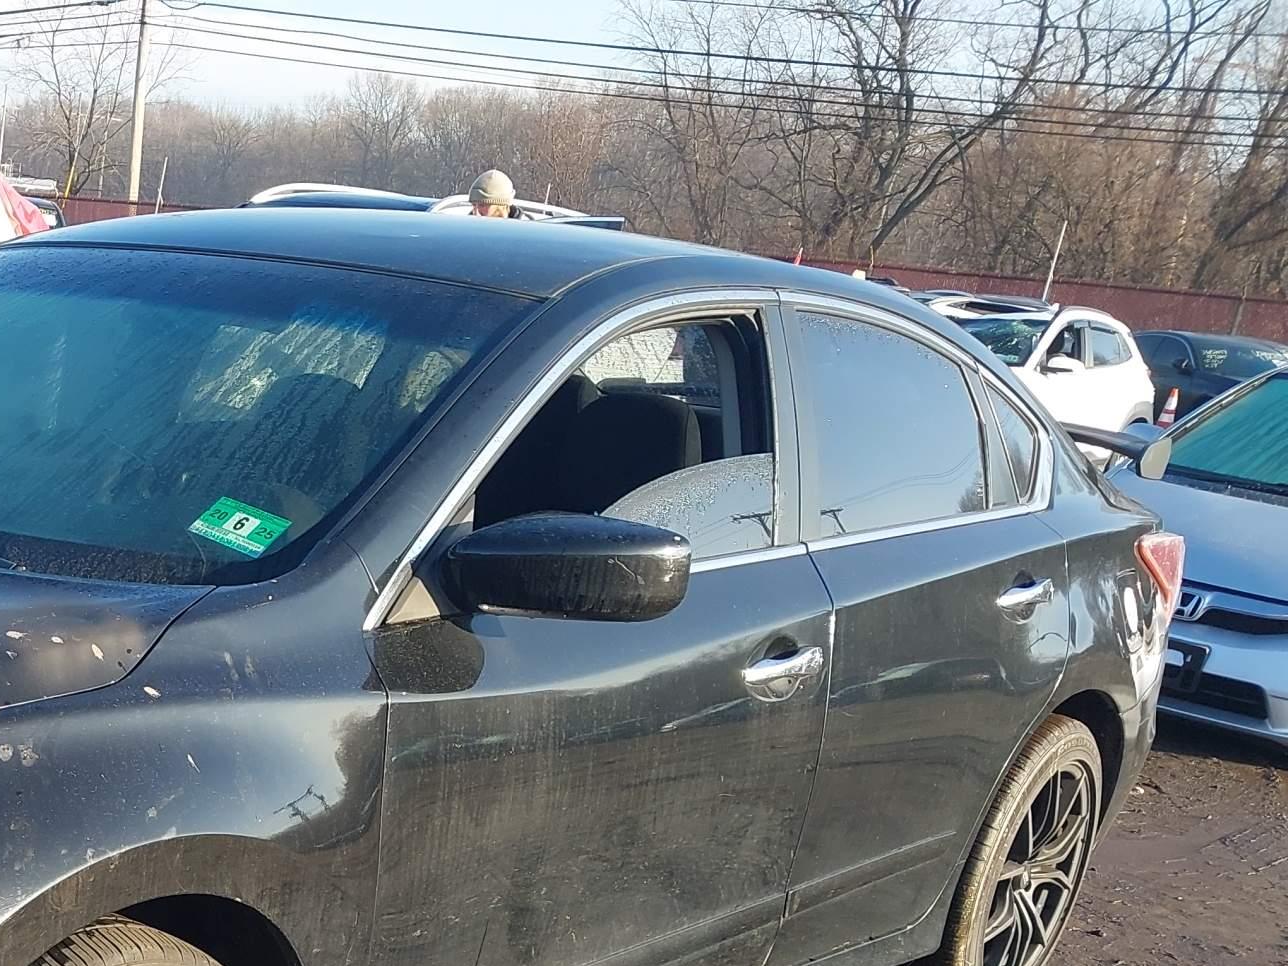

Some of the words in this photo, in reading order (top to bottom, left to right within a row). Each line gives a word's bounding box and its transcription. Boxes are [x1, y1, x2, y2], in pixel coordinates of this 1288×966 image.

[209, 508, 229, 521] 20
[233, 516, 250, 531] 6
[255, 527, 275, 541] 25
